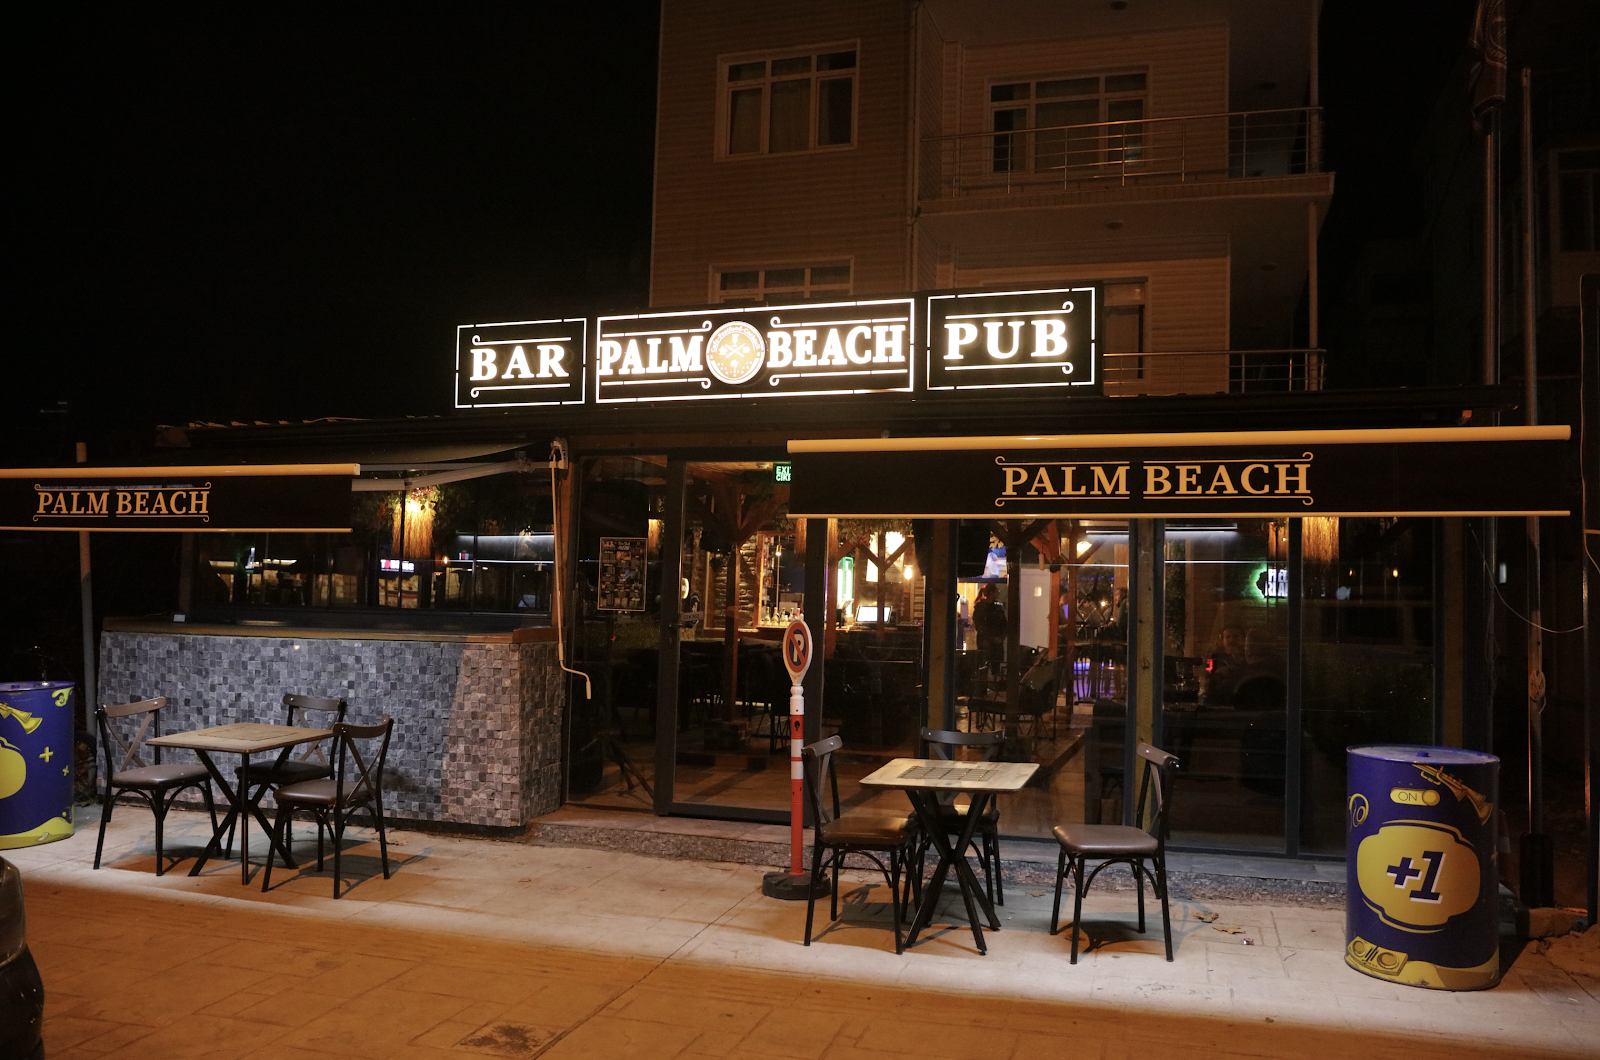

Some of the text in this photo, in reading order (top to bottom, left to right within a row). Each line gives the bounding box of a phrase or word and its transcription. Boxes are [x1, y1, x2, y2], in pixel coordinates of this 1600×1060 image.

[600, 324, 906, 376] PALM BEACH
[943, 318, 1068, 360] PUB
[470, 344, 570, 381] BAR
[776, 465, 792, 474] EXI
[1001, 463, 1311, 496] PALM BEACH
[36, 490, 210, 515] PALM BEACH
[1398, 791, 1418, 802] ON
[1386, 850, 1447, 905] +1
